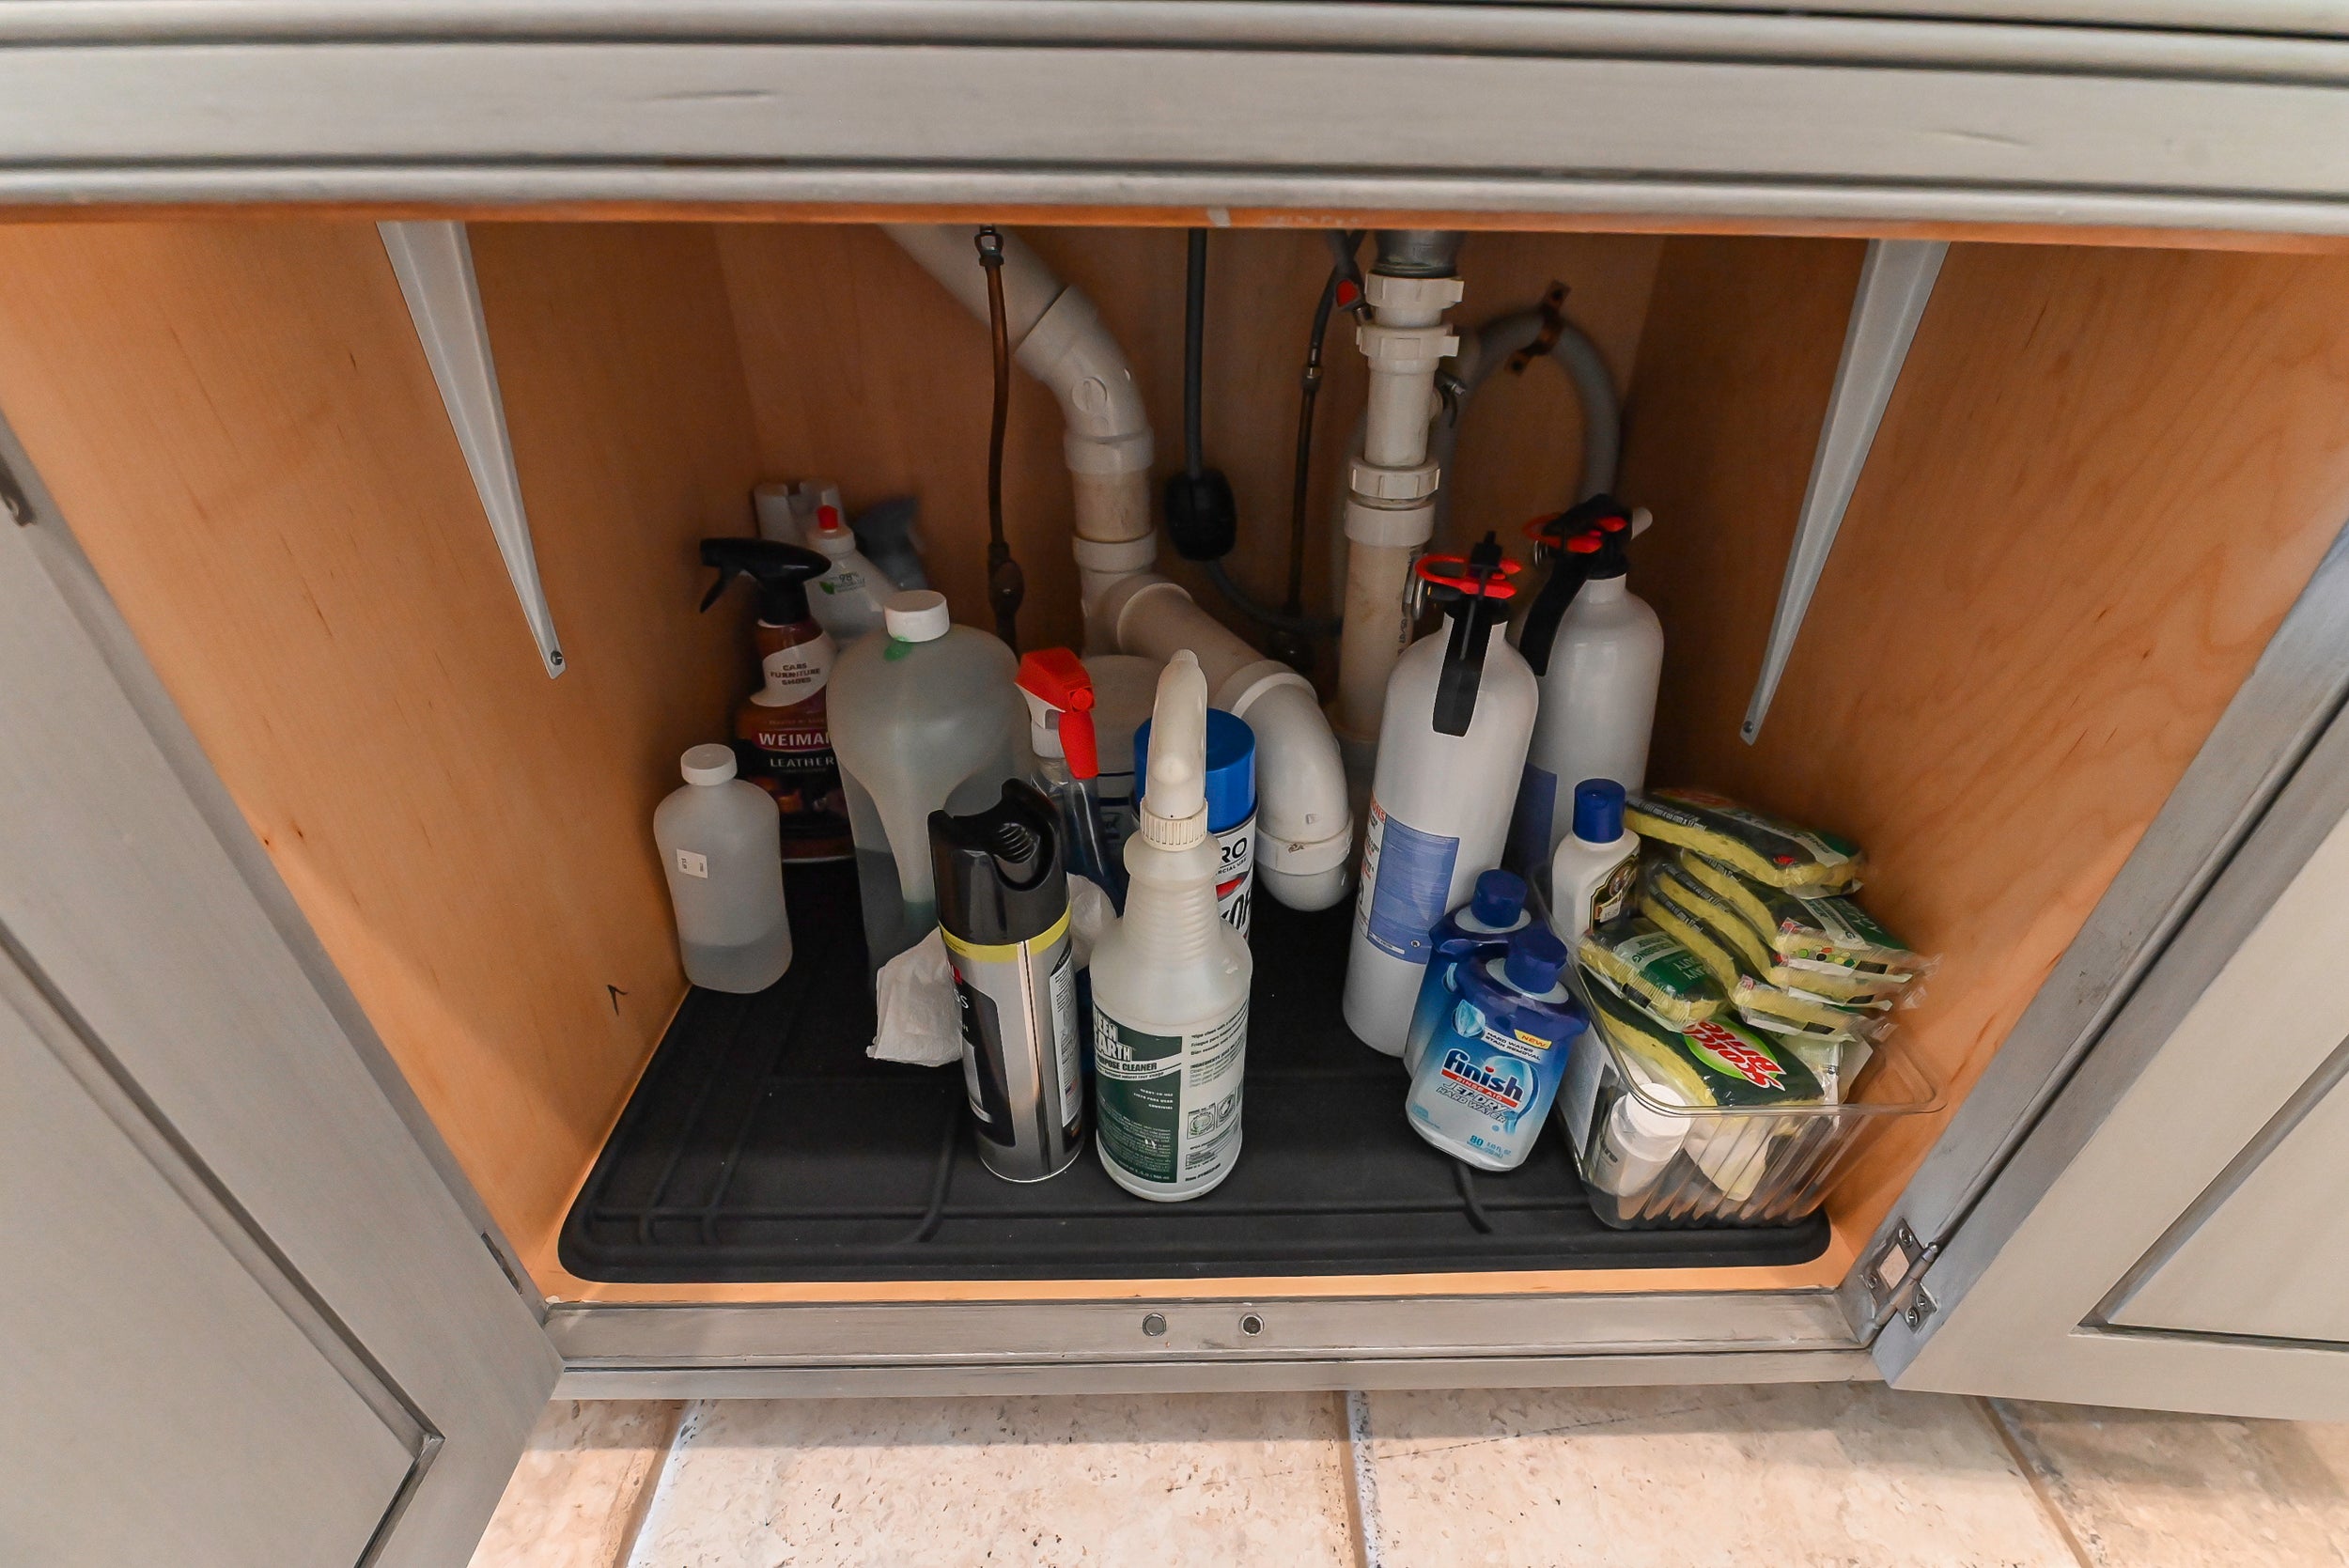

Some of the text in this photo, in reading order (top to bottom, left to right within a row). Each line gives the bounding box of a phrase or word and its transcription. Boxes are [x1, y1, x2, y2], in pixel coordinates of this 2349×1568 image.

[770, 668, 820, 678] FURNITURE
[781, 676, 812, 686] SHOES
[770, 756, 835, 768] LEATHER
[1221, 837, 1248, 863] RO
[1485, 1035, 1541, 1061] STAIN REMOVAL
[1487, 1032, 1547, 1053] HARD WATER NEW
[1122, 1062, 1158, 1072] CLEANER
[1443, 1048, 1524, 1103] finish
[1442, 1081, 1508, 1112] JET-DRY
[1455, 1076, 1502, 1101] RINSE AID
[1436, 1086, 1506, 1124] HARD WATER
[1470, 1134, 1485, 1147] 80
